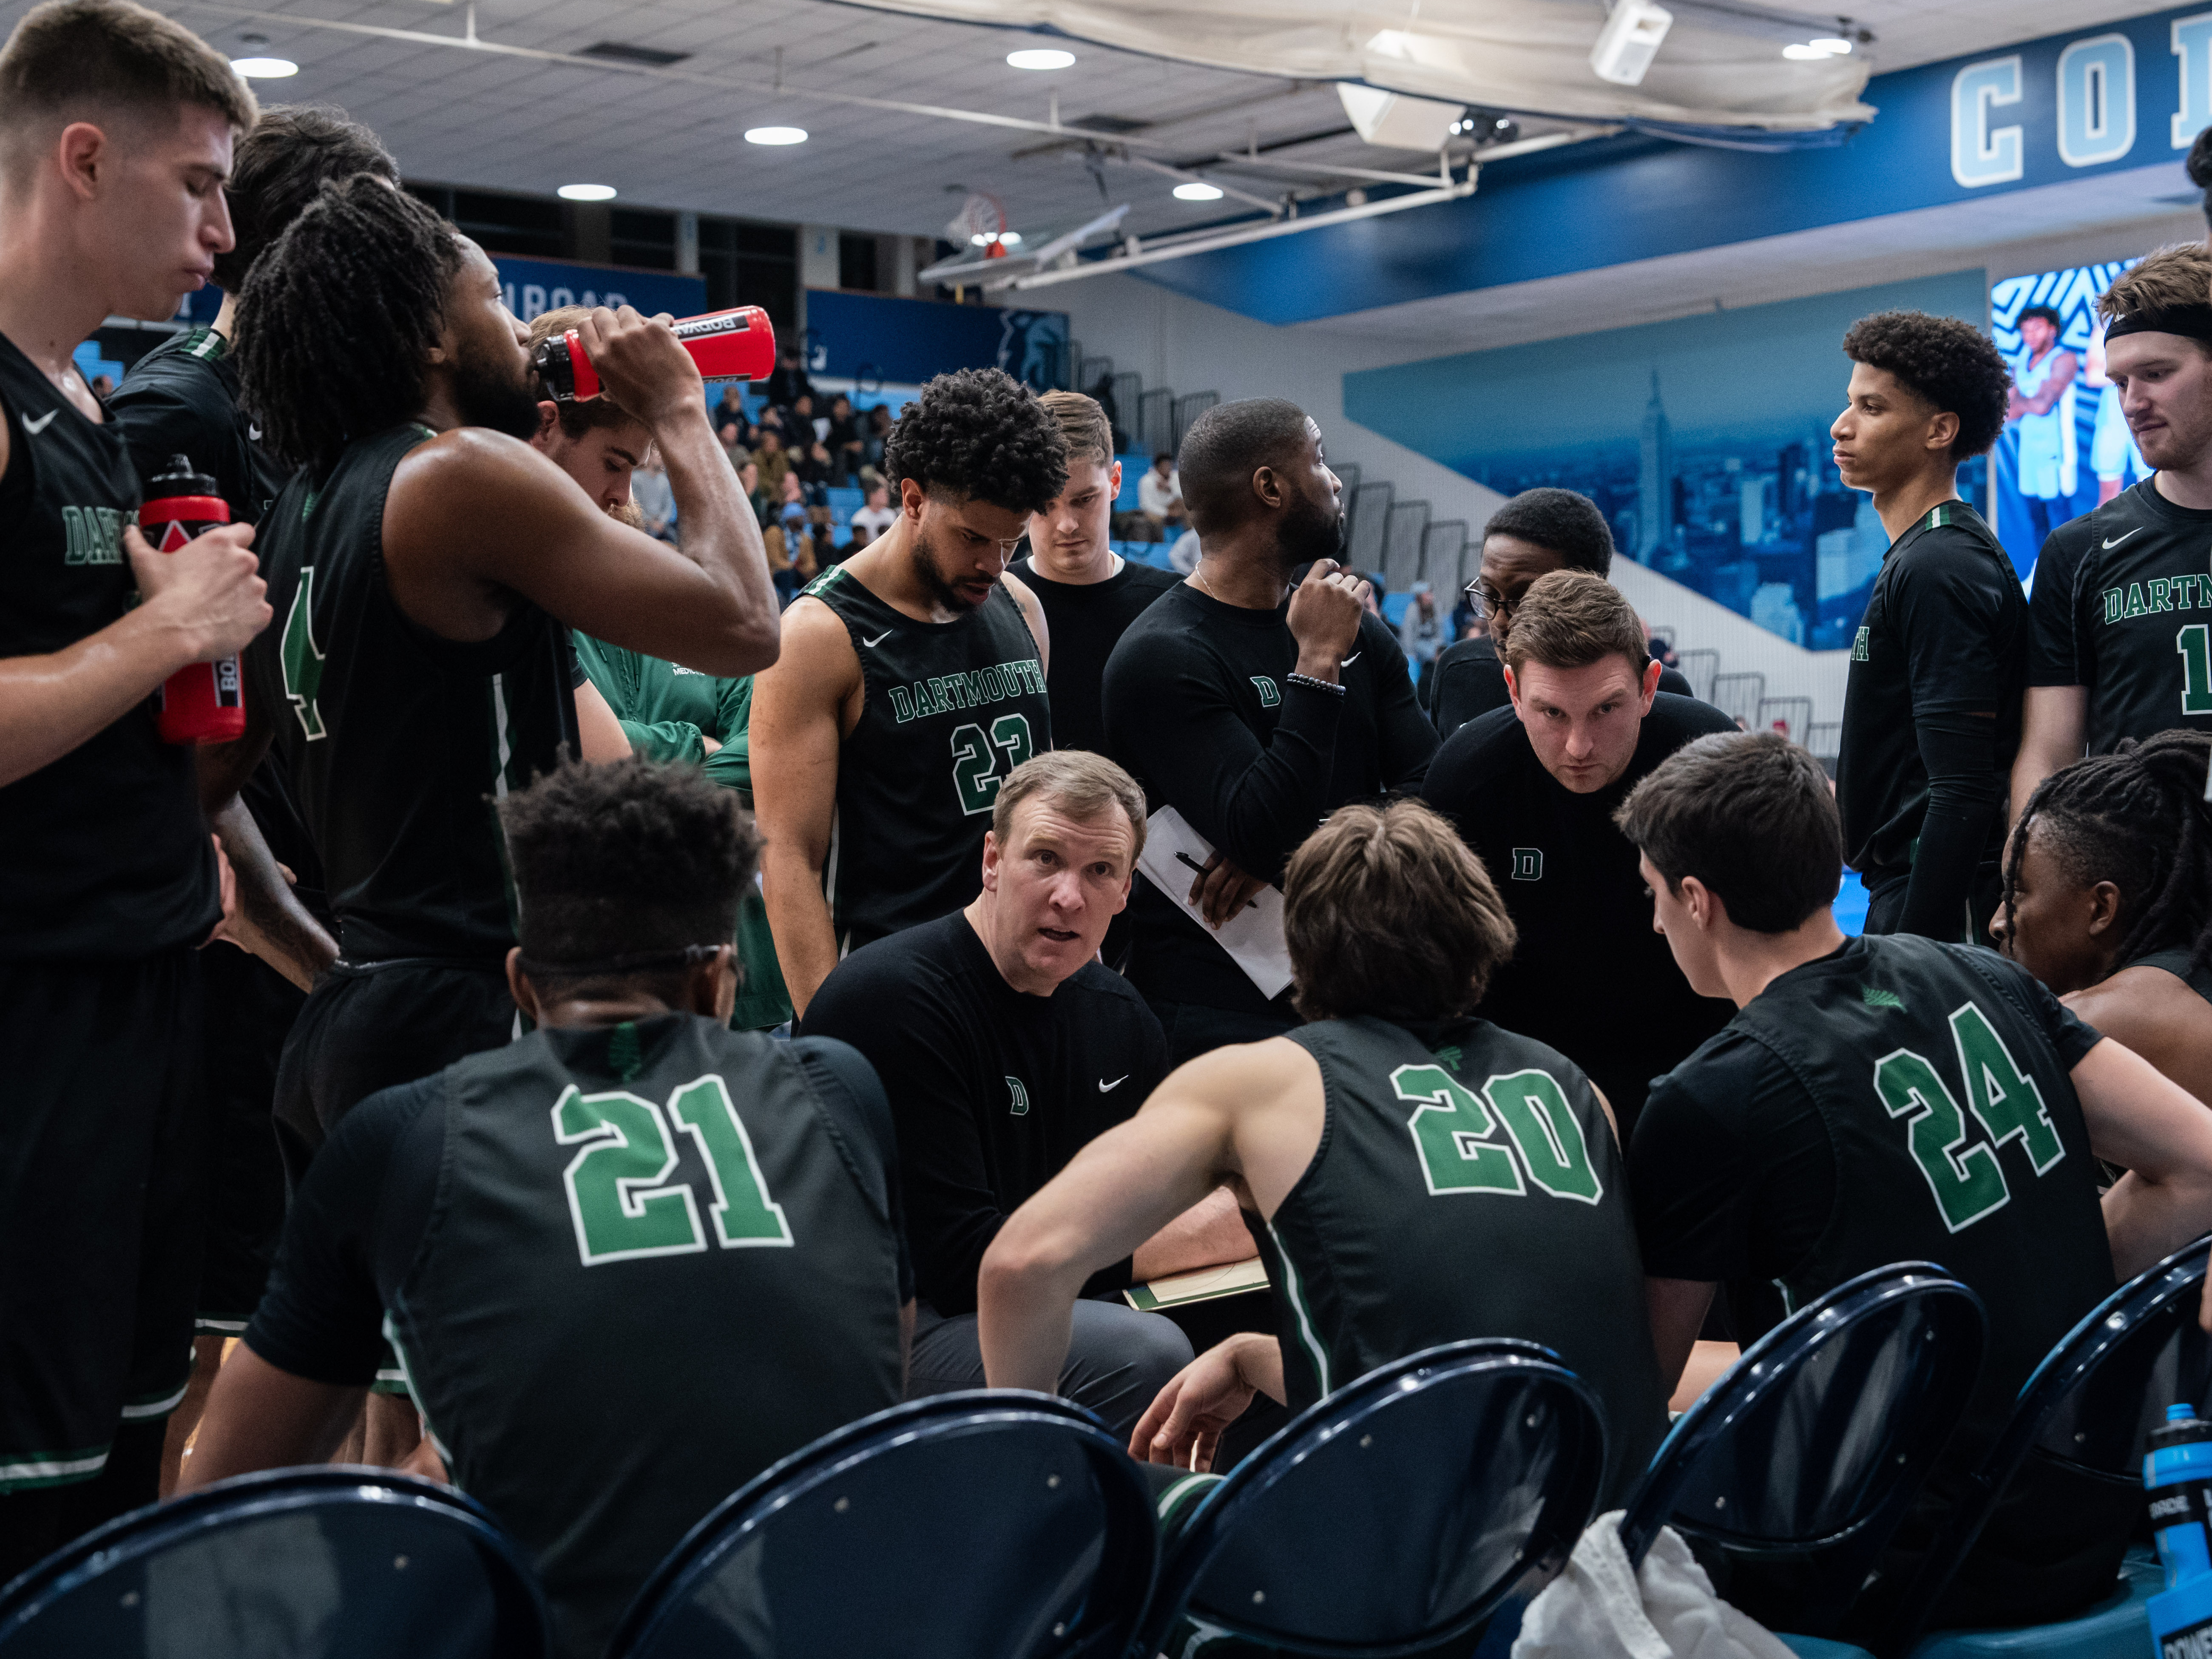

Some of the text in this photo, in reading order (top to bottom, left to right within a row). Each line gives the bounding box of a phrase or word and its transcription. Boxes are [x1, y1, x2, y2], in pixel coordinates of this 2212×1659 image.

[62, 505, 140, 565] DAR
[219, 658, 237, 692] BO
[673, 667, 705, 676] MEDIC
[889, 659, 1046, 723] DARTMOUTH
[1250, 676, 1281, 707] D
[1511, 848, 1543, 881] D
[1005, 1076, 1029, 1115] D
[1873, 1000, 2066, 1233] 24
[1389, 1064, 1604, 1206] 20
[551, 1073, 795, 1267] 21
